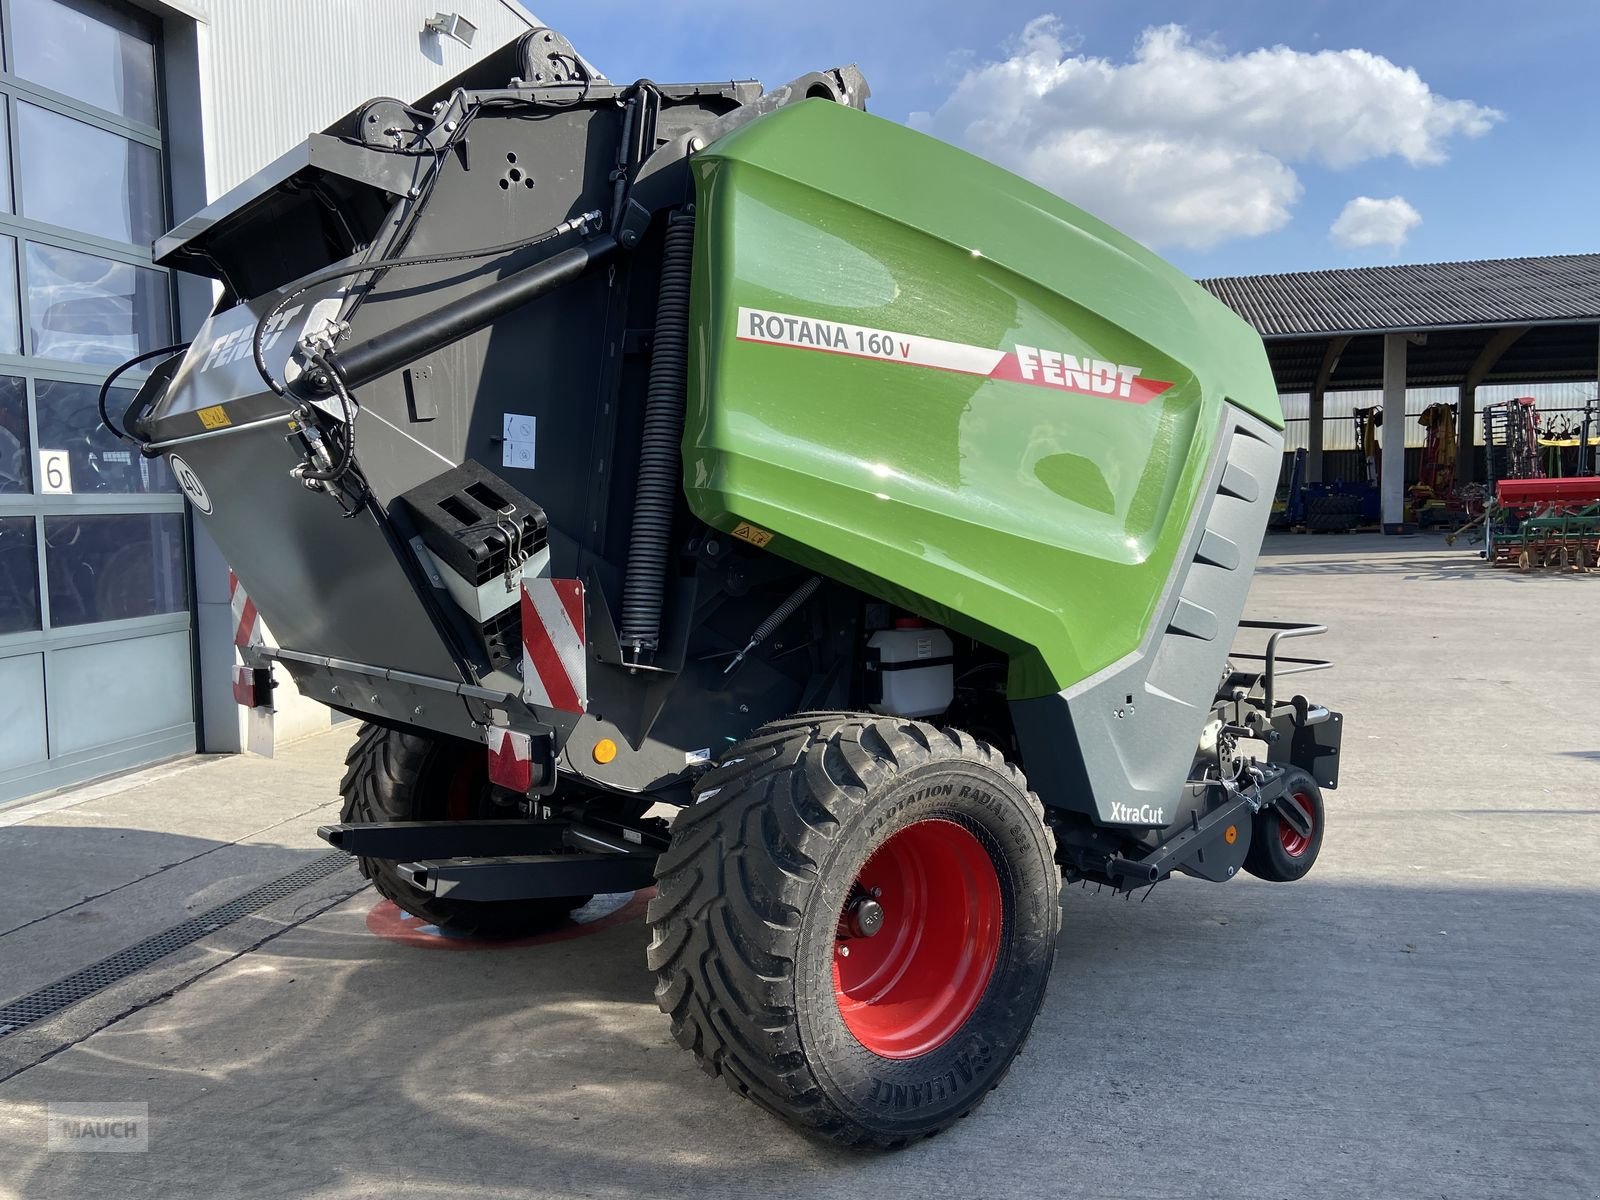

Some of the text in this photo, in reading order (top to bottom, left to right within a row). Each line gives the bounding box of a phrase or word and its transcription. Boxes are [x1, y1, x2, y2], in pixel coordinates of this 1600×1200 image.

[750, 312, 849, 350] ROTANA
[855, 331, 894, 356] 160
[1014, 343, 1143, 398] FENDT
[46, 456, 63, 488] 6
[179, 469, 203, 497] 40
[868, 784, 954, 837] FLOTATION
[959, 785, 1010, 823] RADIAL
[1110, 801, 1164, 824] XtraCut
[866, 1051, 973, 1107] ALLIANCE
